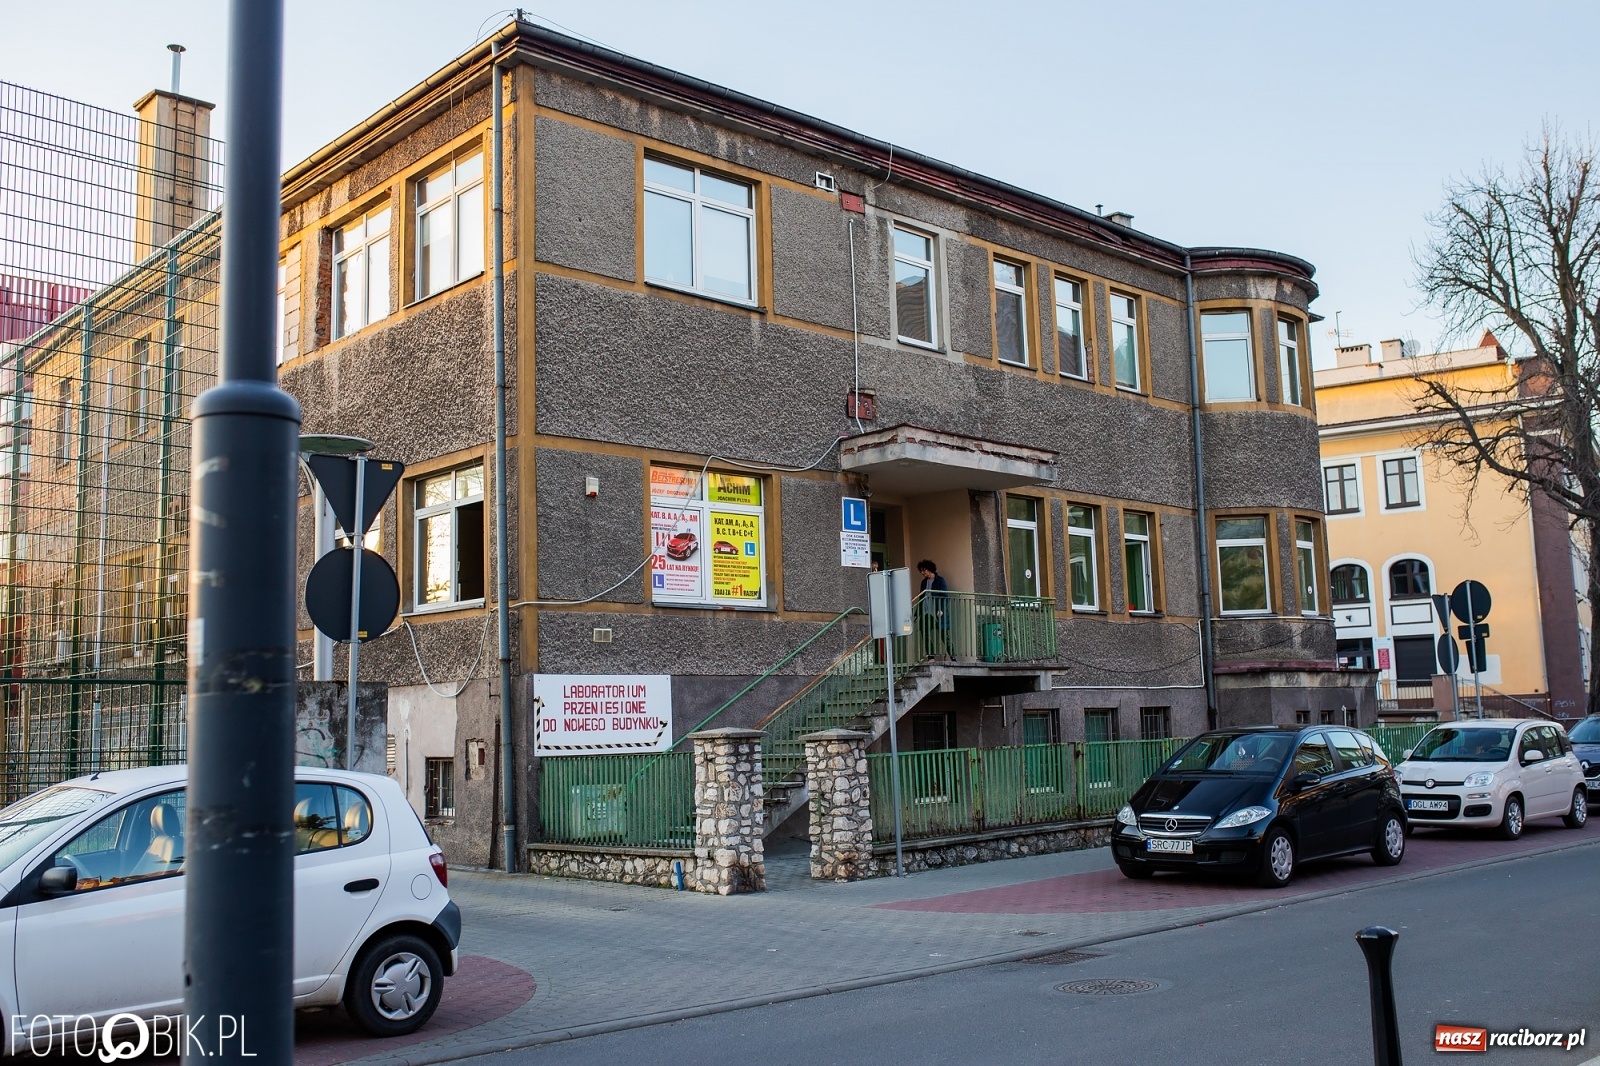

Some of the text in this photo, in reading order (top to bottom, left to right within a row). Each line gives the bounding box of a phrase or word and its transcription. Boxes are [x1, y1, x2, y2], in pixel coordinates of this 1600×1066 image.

[689, 514, 698, 522] AM
[850, 504, 861, 525] L
[651, 554, 666, 570] 25
[666, 563, 675, 571] LAT
[714, 588, 725, 596] ZDAJ
[725, 588, 732, 596] ZA
[731, 584, 743, 597] #1
[563, 684, 646, 699] LABORATORIUM
[563, 700, 647, 715] PRZENIESIONE
[542, 716, 659, 732] DO NOWEGO BUDYNKU
[1429, 801, 1448, 810] AW94
[1151, 839, 1169, 850] SRC
